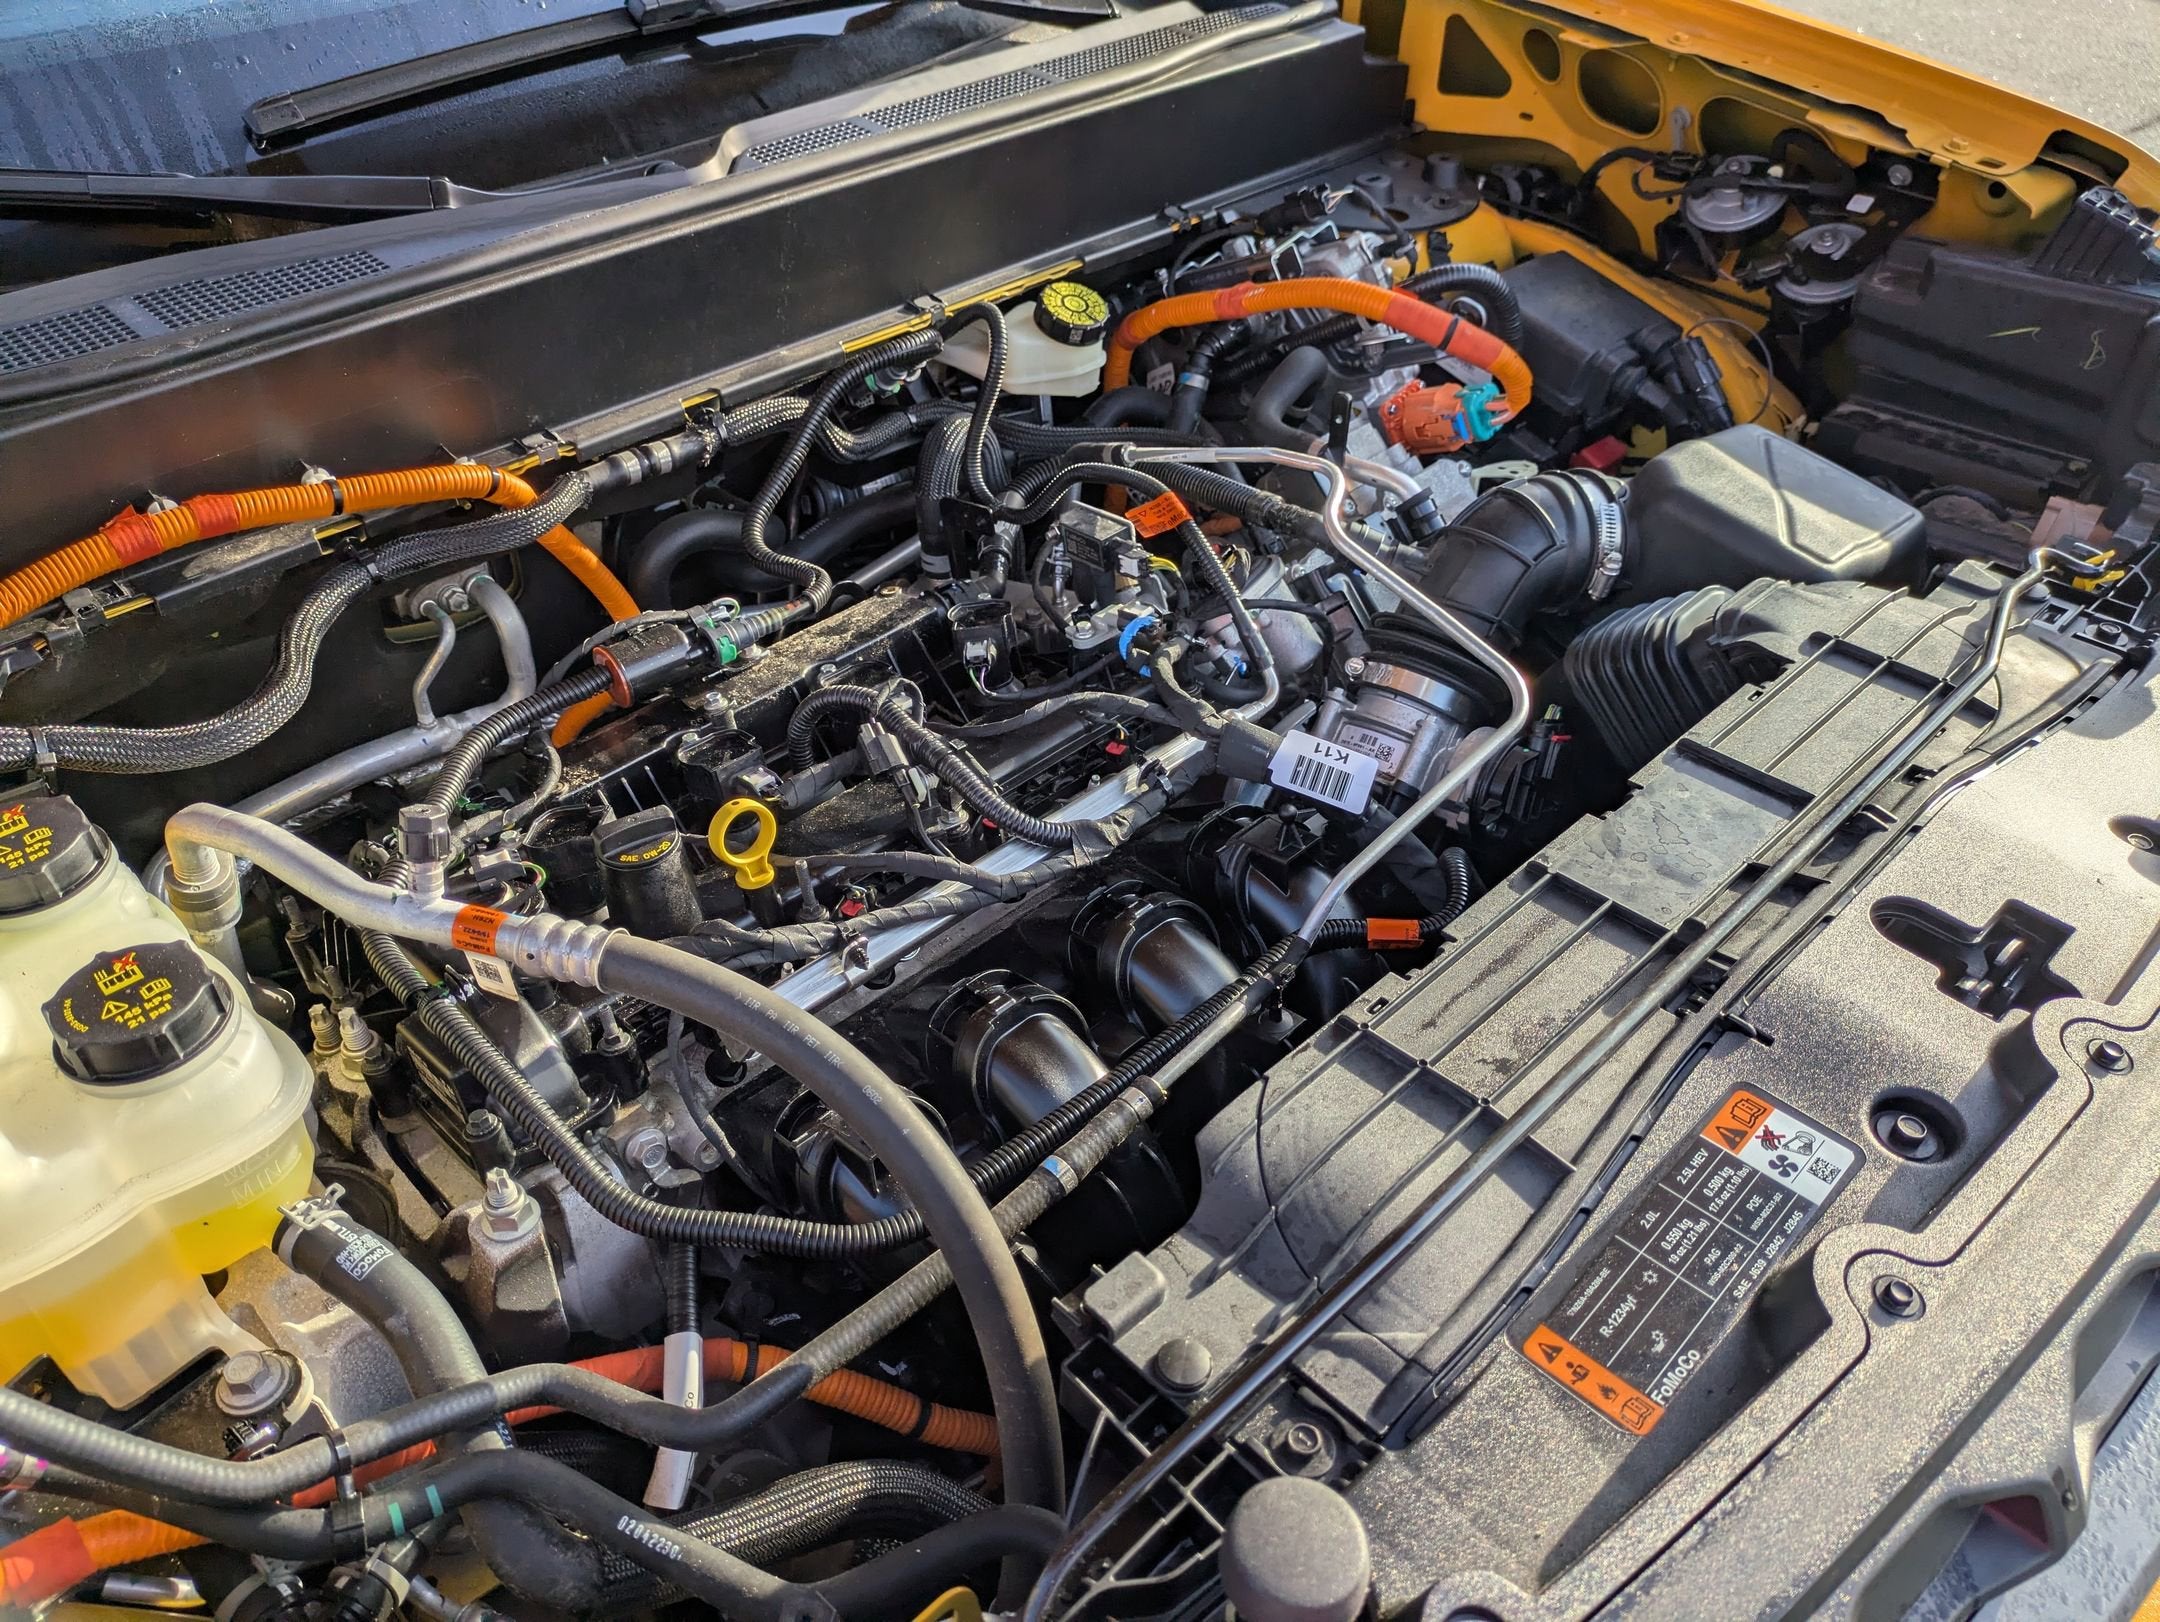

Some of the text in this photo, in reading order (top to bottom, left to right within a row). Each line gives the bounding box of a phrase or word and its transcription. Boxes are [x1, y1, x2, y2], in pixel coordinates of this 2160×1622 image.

[1314, 742, 1350, 765] K11
[8, 848, 50, 869] 21 psi
[25, 840, 52, 854] kPa
[620, 840, 671, 862] SAE 0W-20
[115, 993, 173, 1024] 145 kPa
[127, 1003, 172, 1030] 21 psi
[765, 1008, 778, 1021] PA
[802, 1033, 821, 1050] PET
[231, 1159, 282, 1206] MIN
[1677, 1149, 1710, 1186] 2.5L HEV
[1703, 1166, 1734, 1198] 0.500 kg
[1708, 1165, 1753, 1214] 17.6 oz (1.10 lbs)
[1746, 1195, 1763, 1213] POE
[1640, 1209, 1660, 1230] 2.0L
[1661, 1218, 1693, 1251] 0.550 kg
[1668, 1219, 1710, 1265] 19 oz (1.21 lbs)
[1704, 1248, 1721, 1267] PAG
[1732, 1211, 1803, 1300] SAE J639 J2842 J2845
[353, 1246, 390, 1277] FoMoCo
[1600, 1293, 1638, 1338] R-1234yf
[1650, 1347, 1701, 1407] FoMoCo
